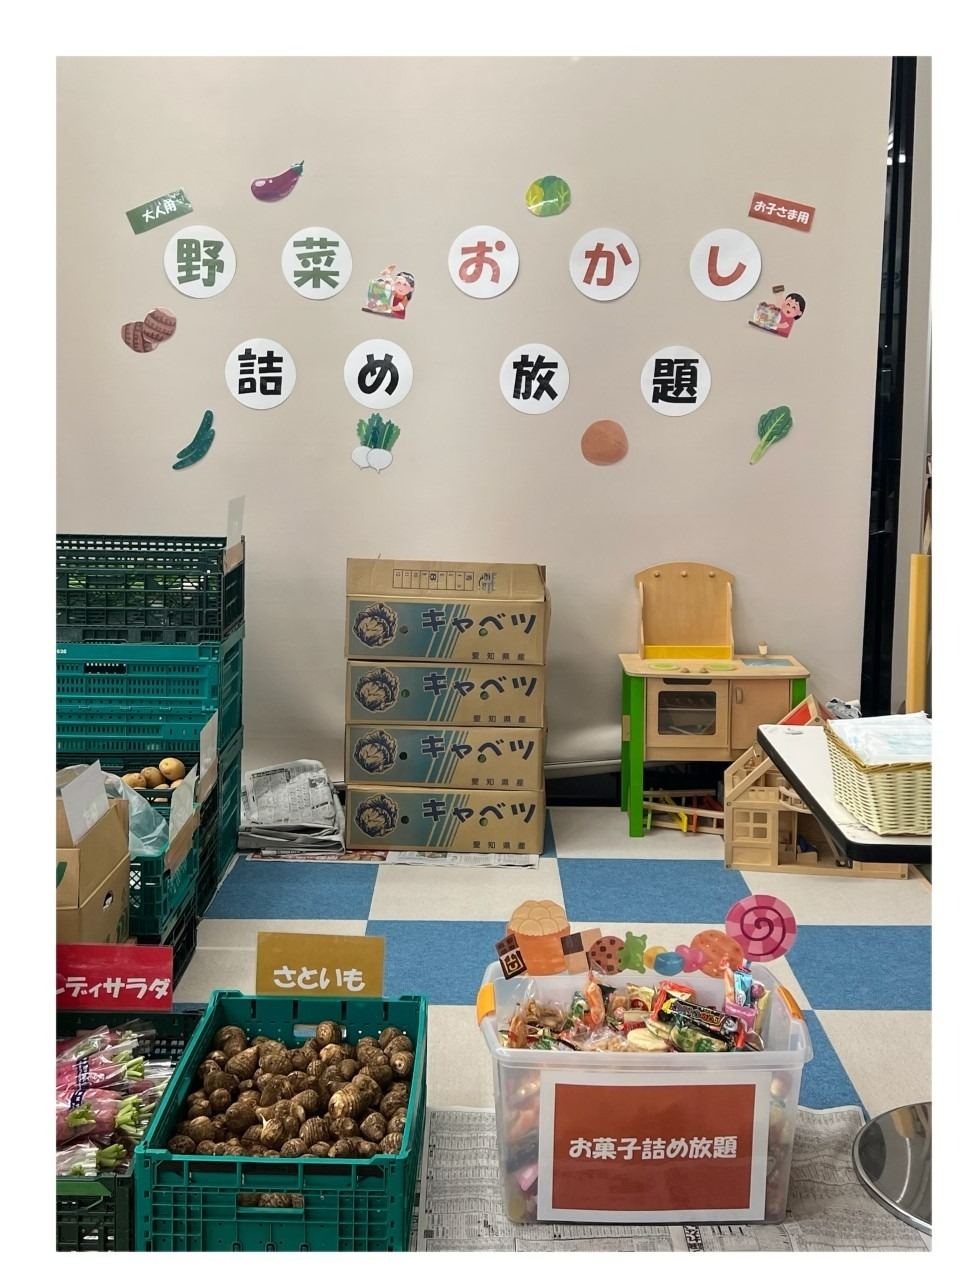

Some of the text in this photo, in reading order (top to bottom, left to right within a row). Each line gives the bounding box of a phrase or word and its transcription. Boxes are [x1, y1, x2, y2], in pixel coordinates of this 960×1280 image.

[753, 200, 810, 225] お子さま用
[176, 238, 341, 290] 野菜
[421, 607, 537, 634] キャベツ
[422, 671, 538, 697] キャベツ
[420, 734, 535, 760] キャベツ
[422, 798, 537, 824] キャベツ
[56, 976, 171, 1000] ディサラダ
[273, 965, 367, 992] さといも
[568, 1135, 738, 1162] お菓子詰め放題
